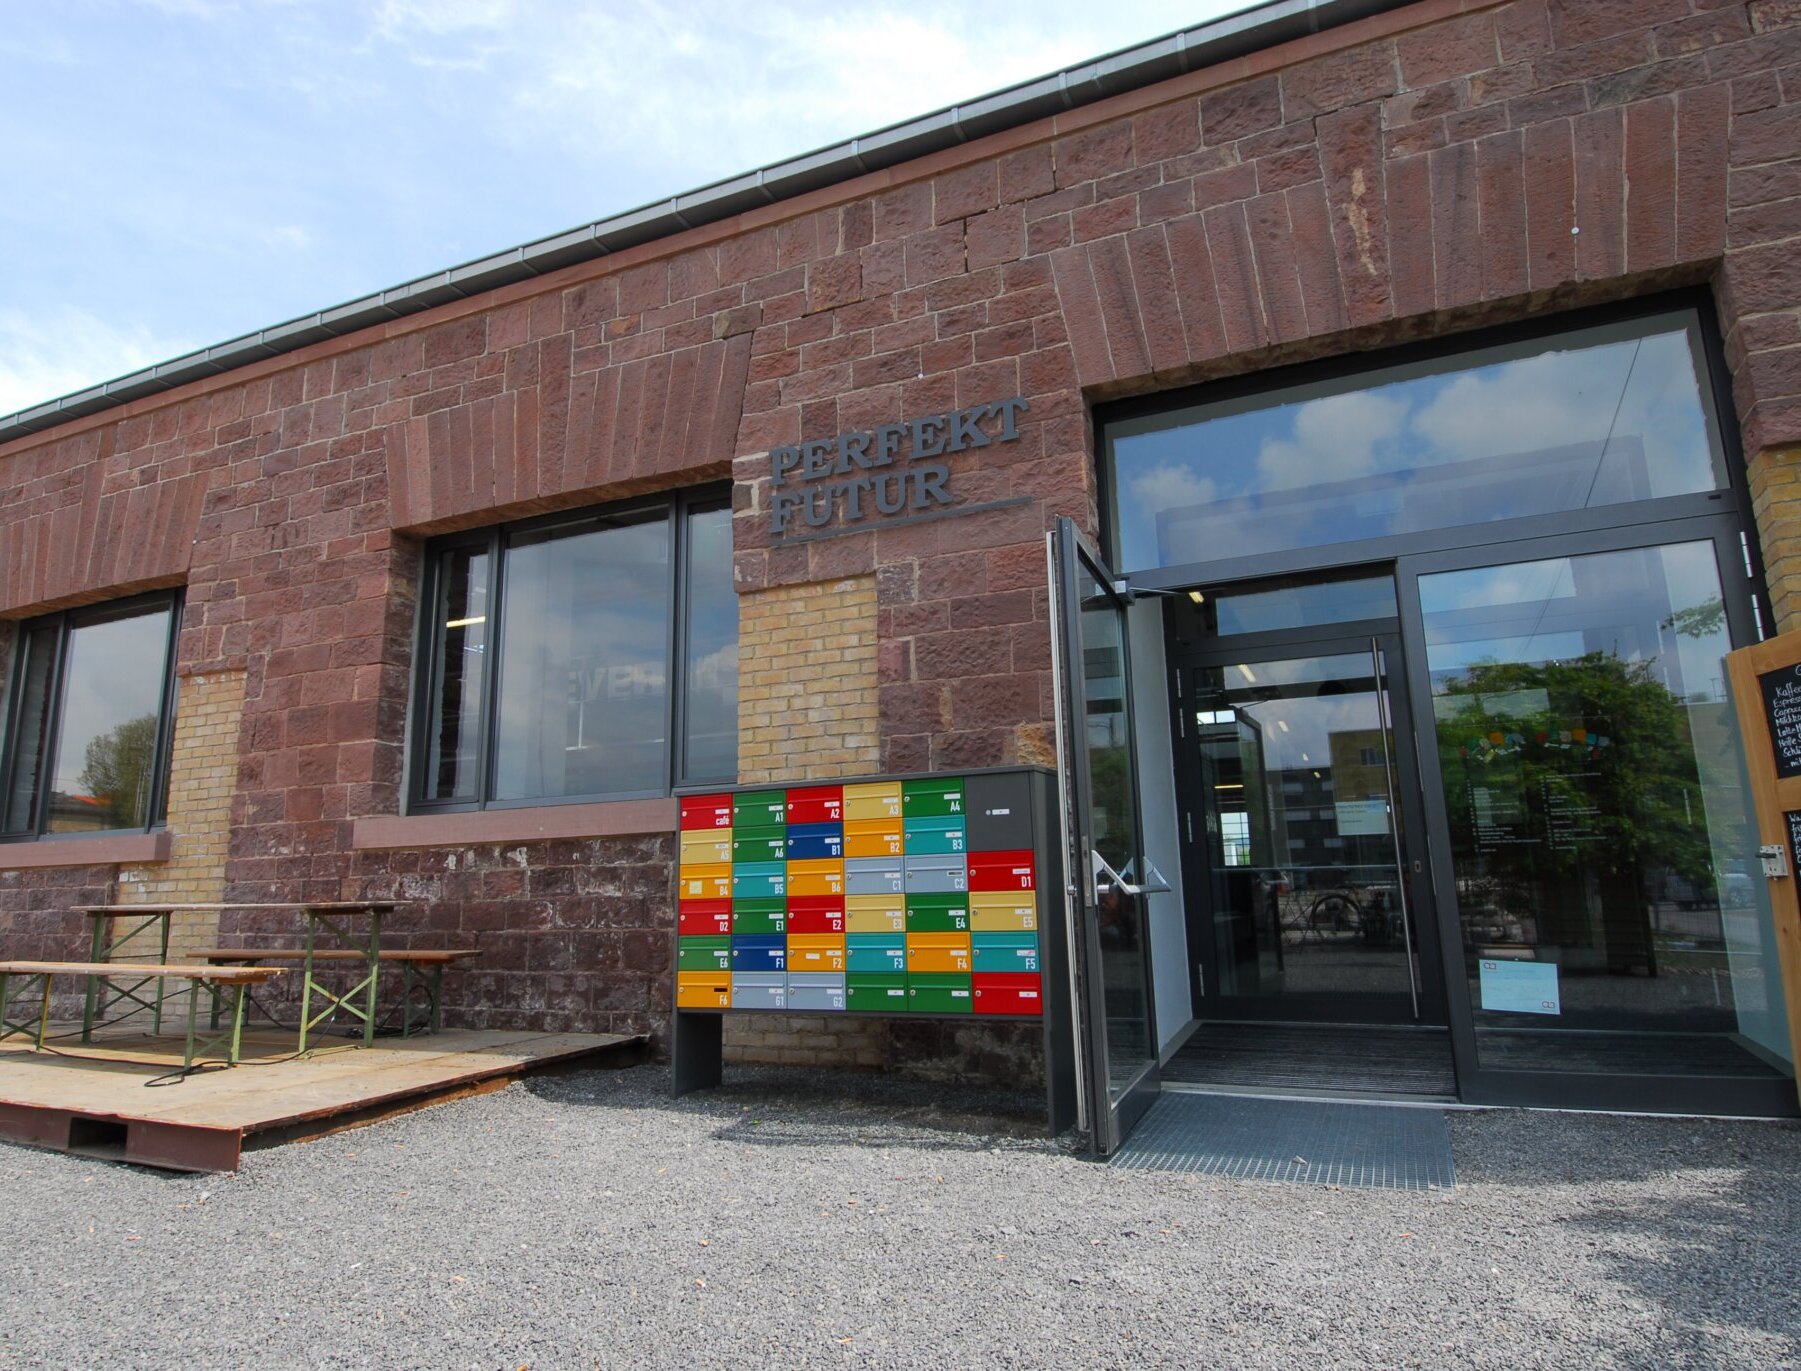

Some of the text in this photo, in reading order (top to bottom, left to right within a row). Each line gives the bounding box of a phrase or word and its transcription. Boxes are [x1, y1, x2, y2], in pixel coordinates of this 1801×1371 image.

[769, 396, 1030, 486] PERFEKT
[769, 464, 954, 534] FUTUR
[950, 801, 961, 812] A4
[775, 812, 784, 822] A1
[830, 808, 840, 819] A2
[715, 816, 730, 826] café
[774, 848, 784, 858] A6
[831, 845, 841, 856] B1
[831, 882, 841, 892] B6
[892, 880, 901, 891] C1
[1021, 876, 1032, 887] D1
[774, 884, 784, 894] B5
[776, 921, 784, 931] E1
[832, 919, 842, 930] E2
[955, 918, 966, 929] E4
[719, 958, 728, 968] E6
[775, 957, 784, 968] F1
[832, 957, 842, 969] F2
[894, 958, 903, 969] F3
[1025, 958, 1036, 970] F5
[833, 996, 843, 1007] G2
